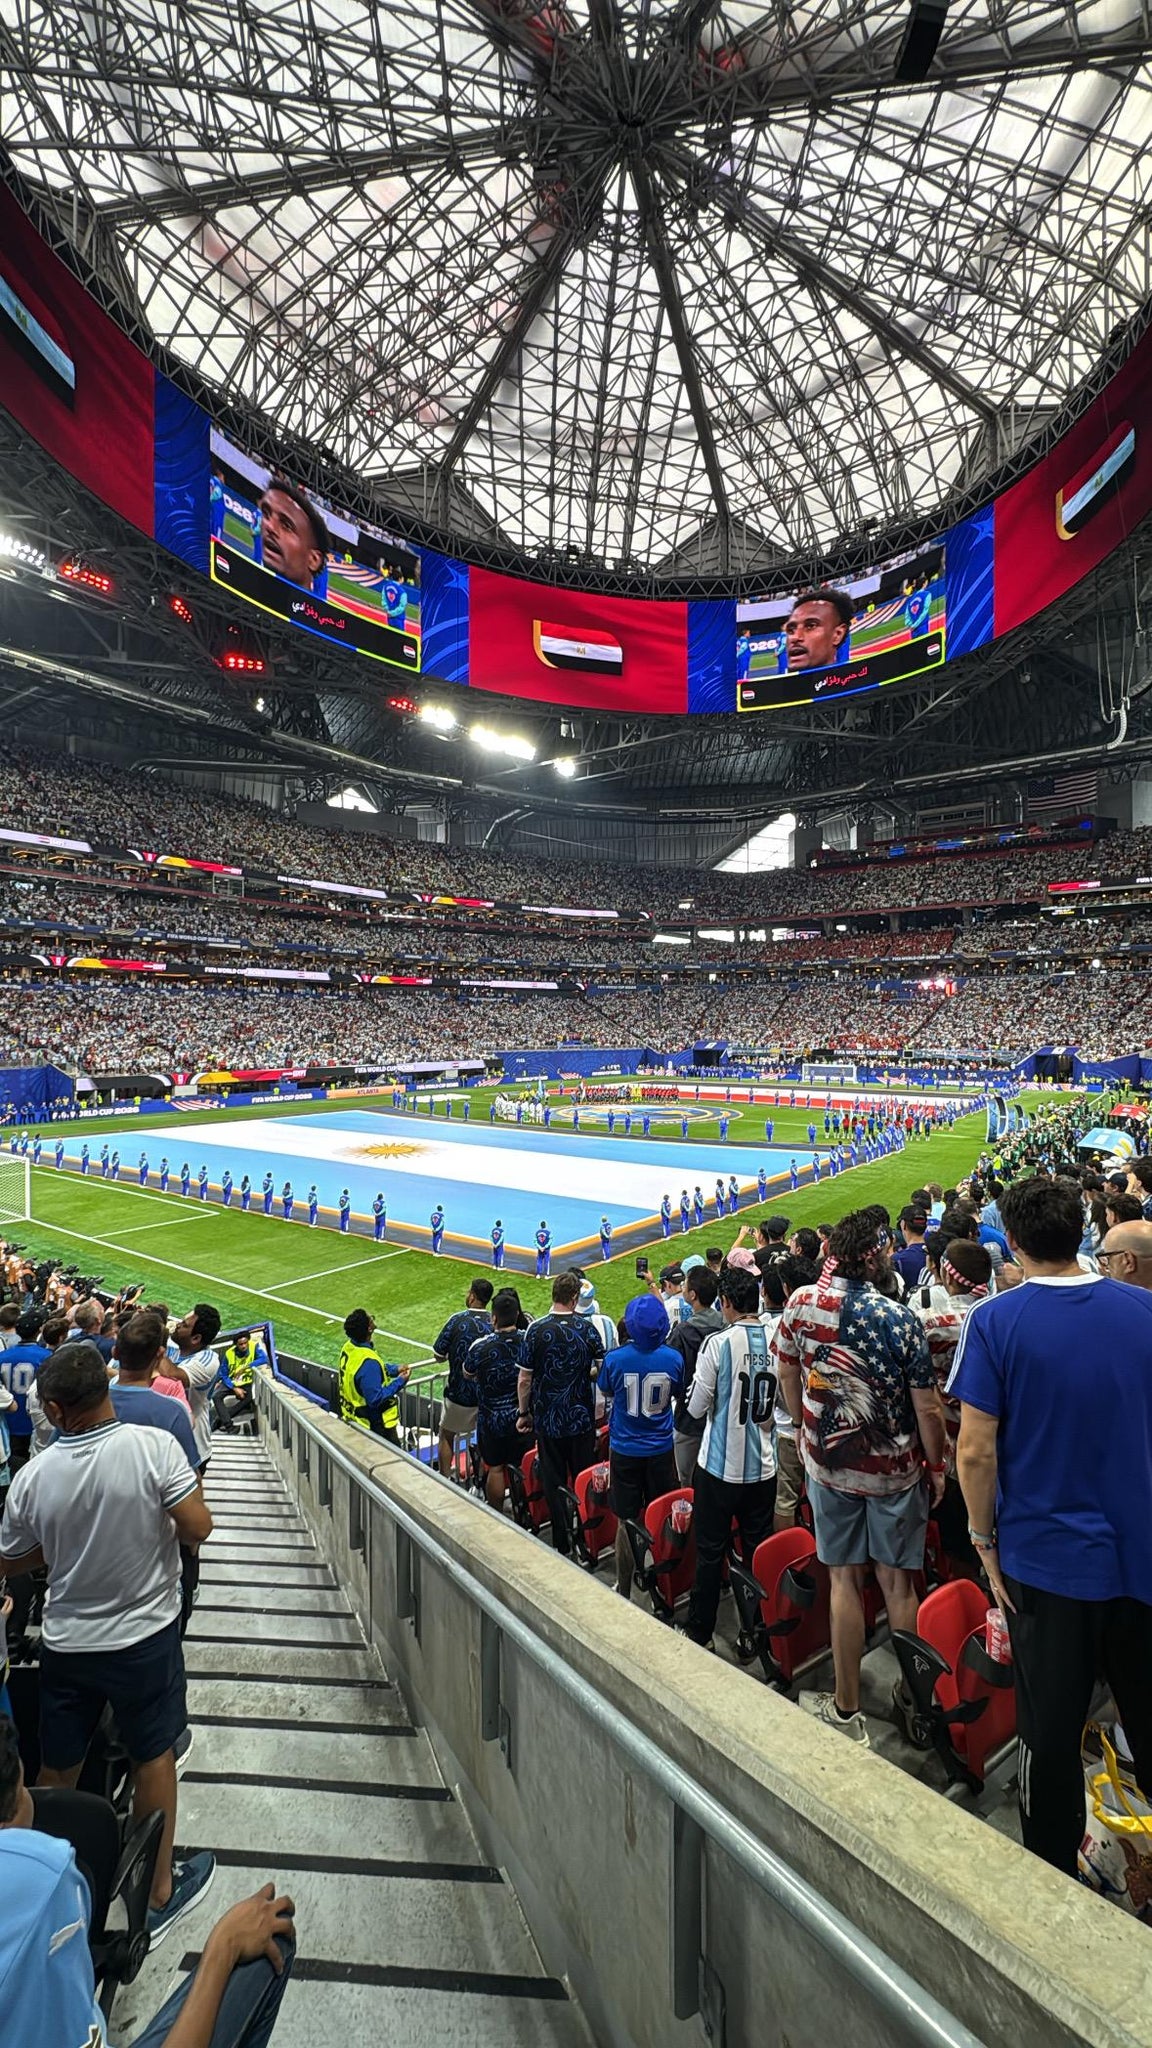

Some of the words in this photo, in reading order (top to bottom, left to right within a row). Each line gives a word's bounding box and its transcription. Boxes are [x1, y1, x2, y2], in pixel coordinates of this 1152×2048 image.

[223, 493, 254, 522] 026
[749, 640, 777, 652] 026
[331, 947, 358, 955] ATLANTA
[205, 966, 216, 974] FIFA
[217, 967, 237, 975] WORLD
[252, 1096, 264, 1104] FIFA
[99, 1108, 114, 1116] CUP
[114, 1106, 140, 1115] 2026
[743, 1353, 774, 1366] MESSI
[1, 1362, 35, 1395] 10
[624, 1372, 671, 1418] 10
[738, 1371, 777, 1425] 10
